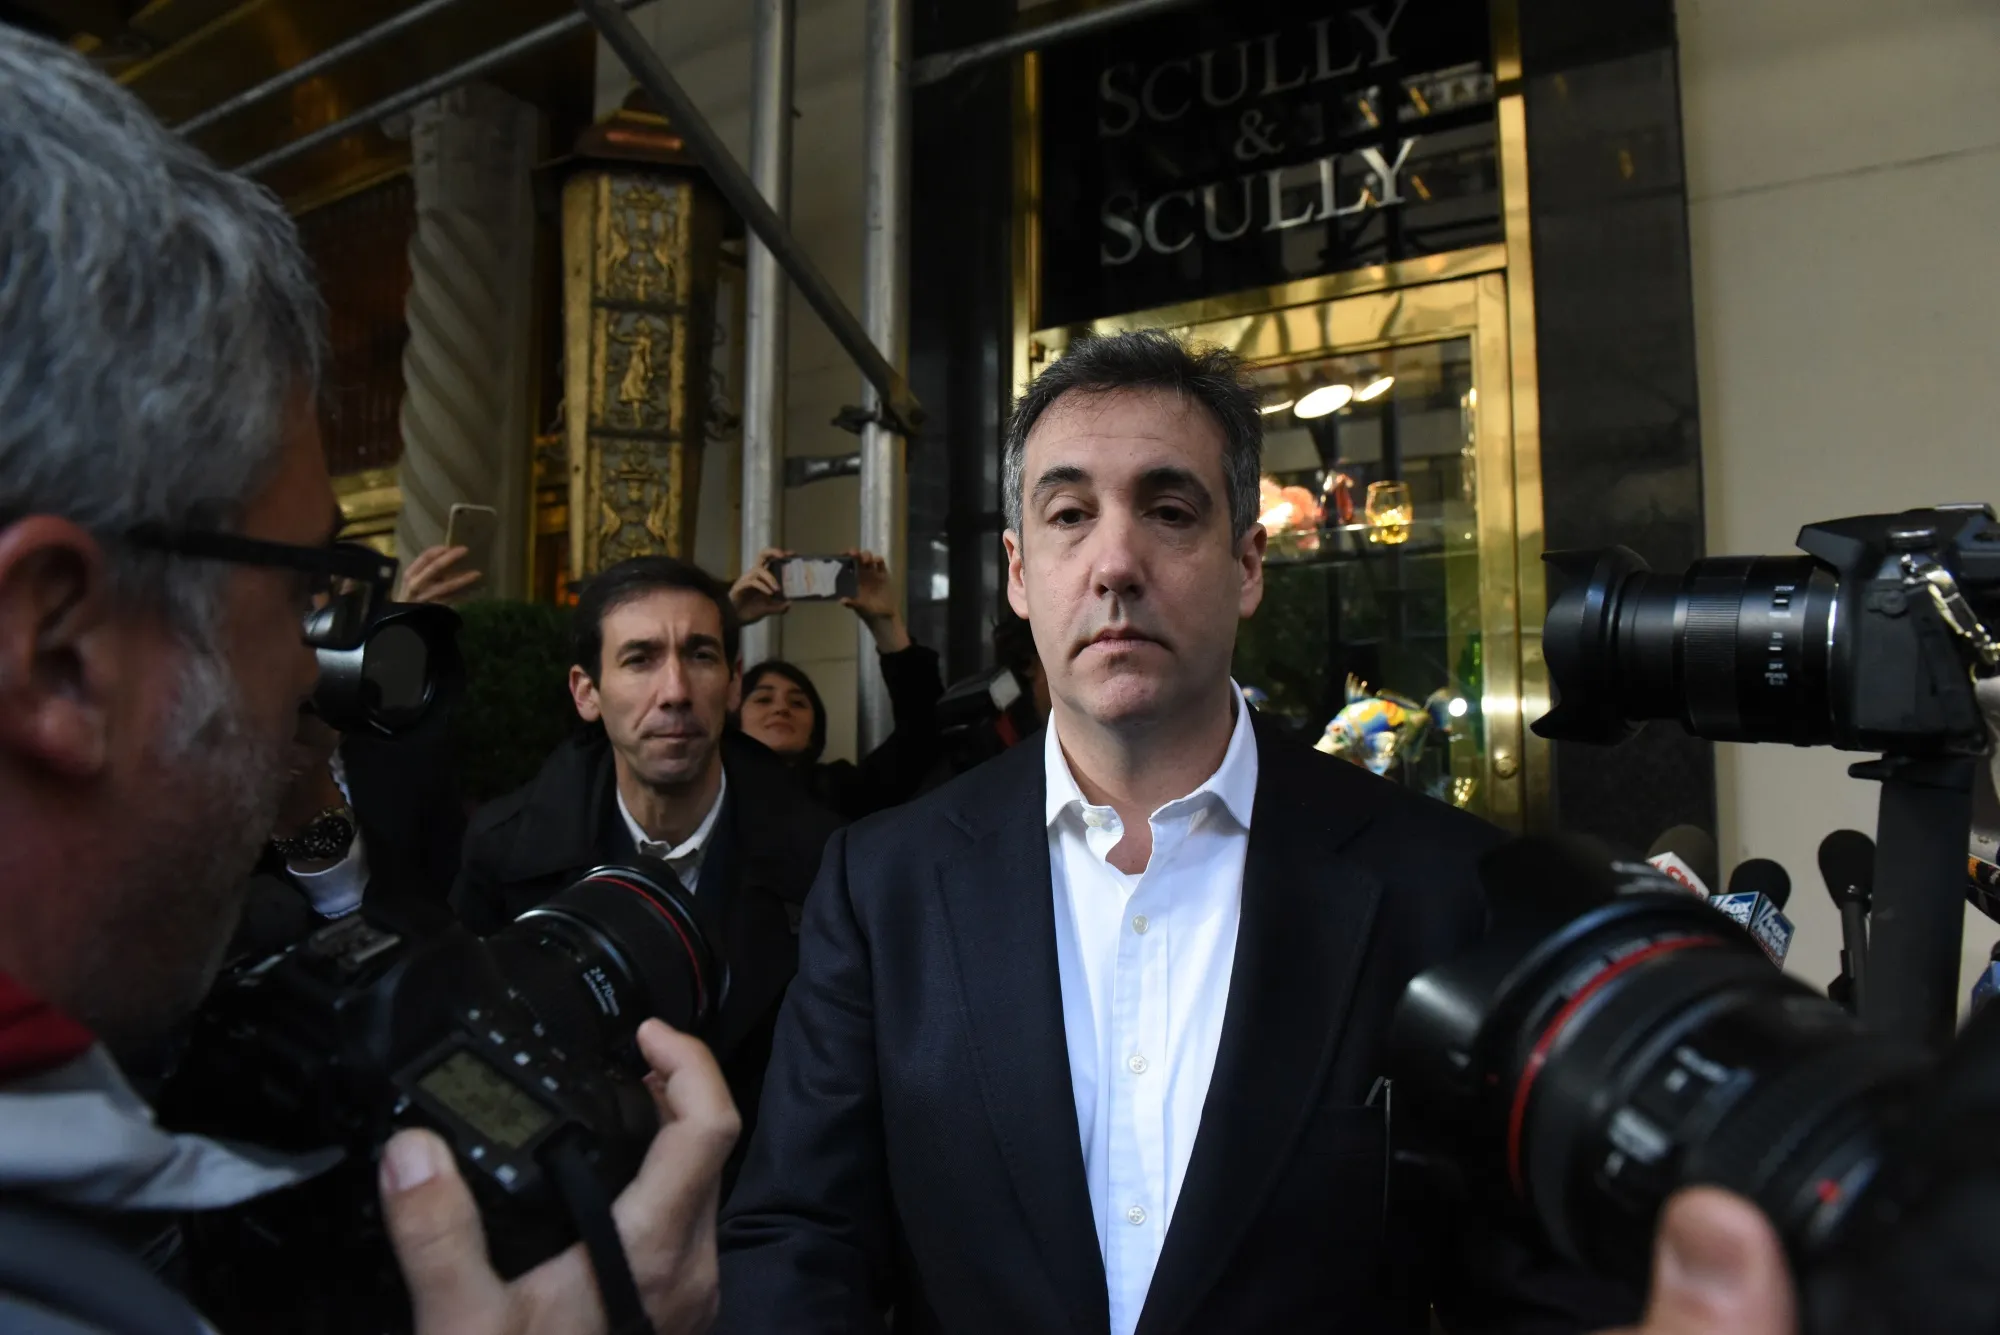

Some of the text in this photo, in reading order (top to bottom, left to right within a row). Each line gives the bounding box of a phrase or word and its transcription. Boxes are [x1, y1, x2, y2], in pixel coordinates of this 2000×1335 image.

[1098, 0, 1408, 137] SCULLY
[1100, 135, 1421, 266] SCULLY
[1233, 109, 1285, 161] &
